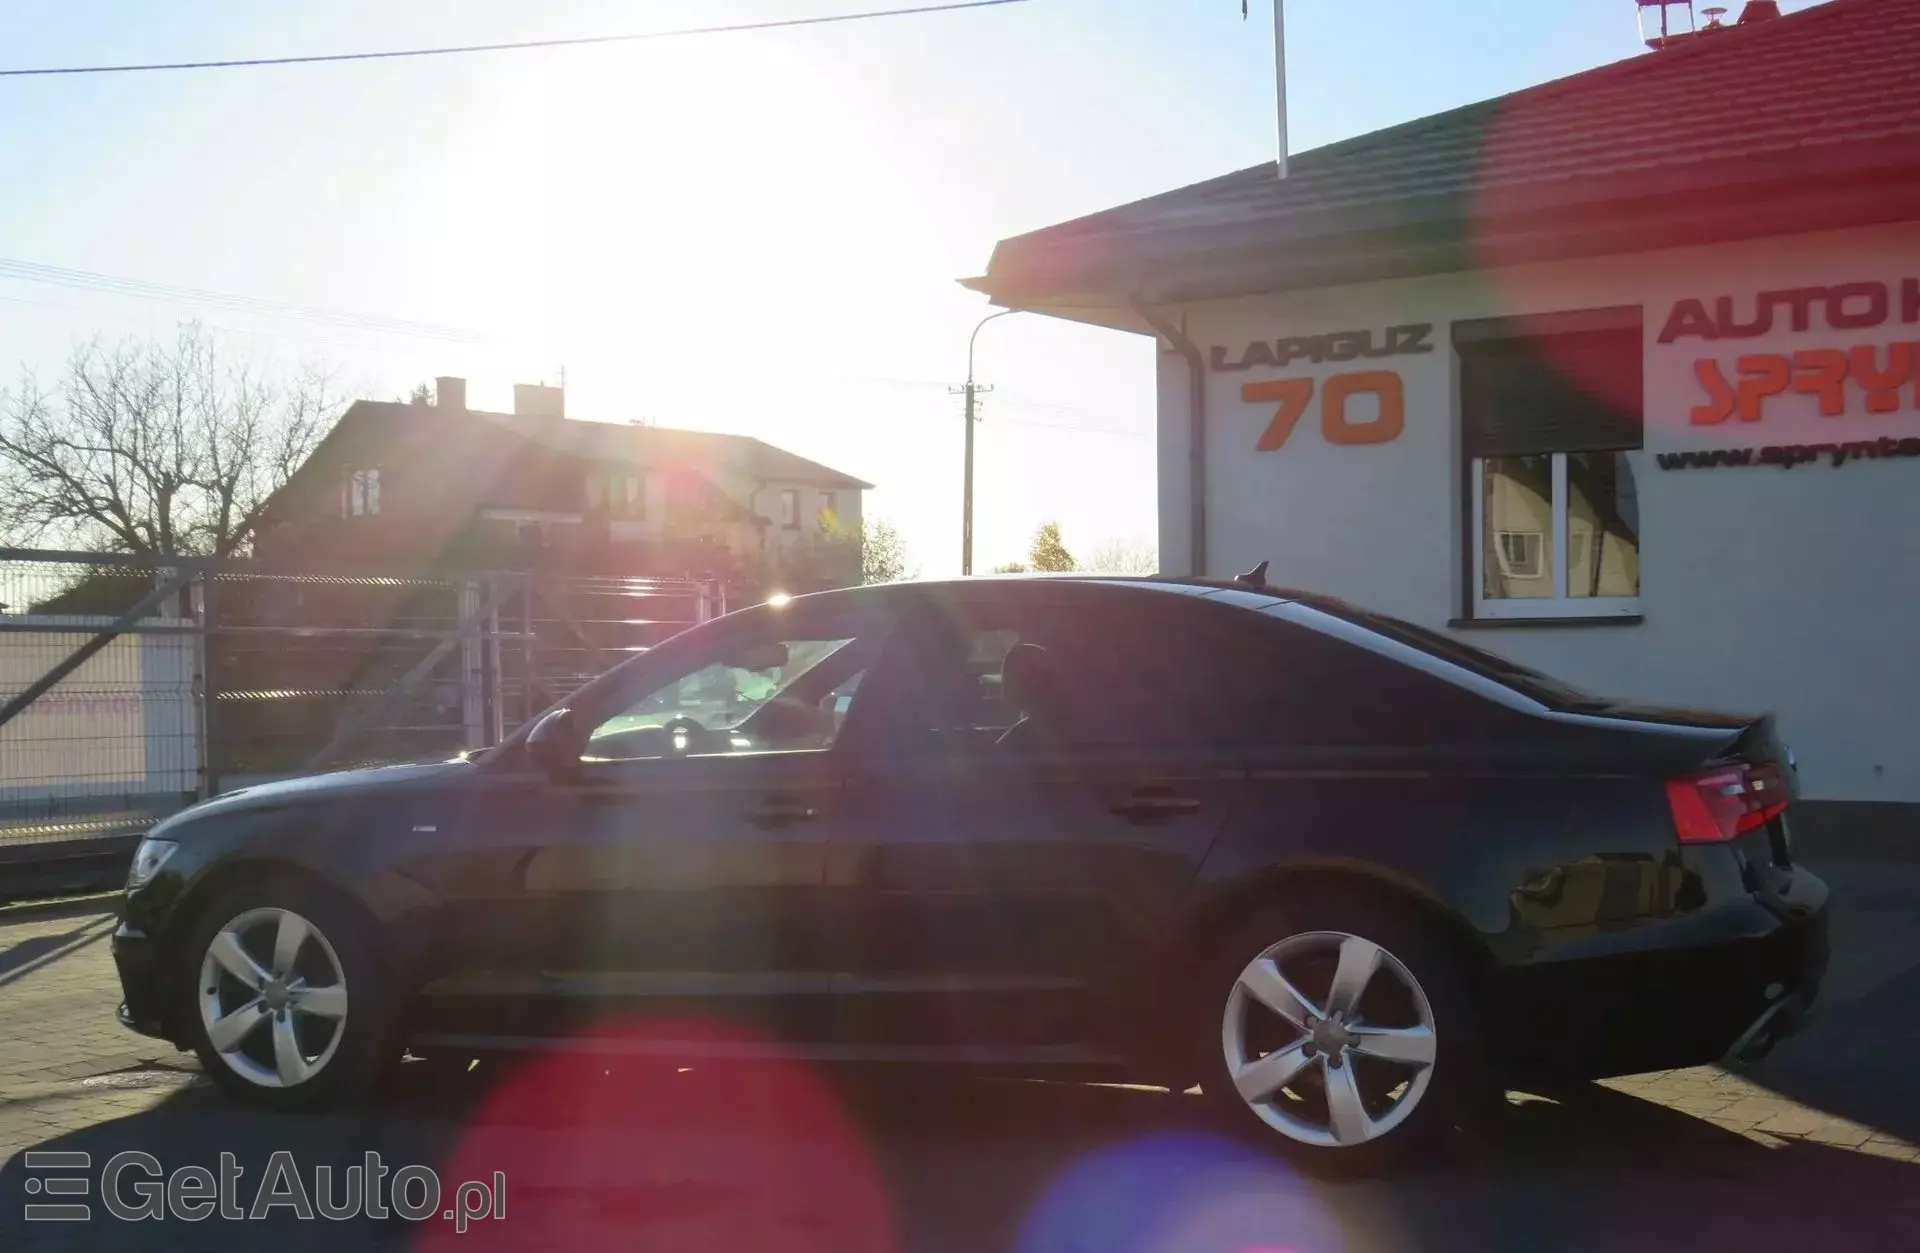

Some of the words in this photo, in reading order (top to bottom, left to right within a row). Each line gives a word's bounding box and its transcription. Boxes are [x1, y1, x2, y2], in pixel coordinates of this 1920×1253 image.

[1657, 281, 1888, 343] AUTO
[1241, 370, 1404, 451] 70
[1690, 342, 1920, 426] SPRY
